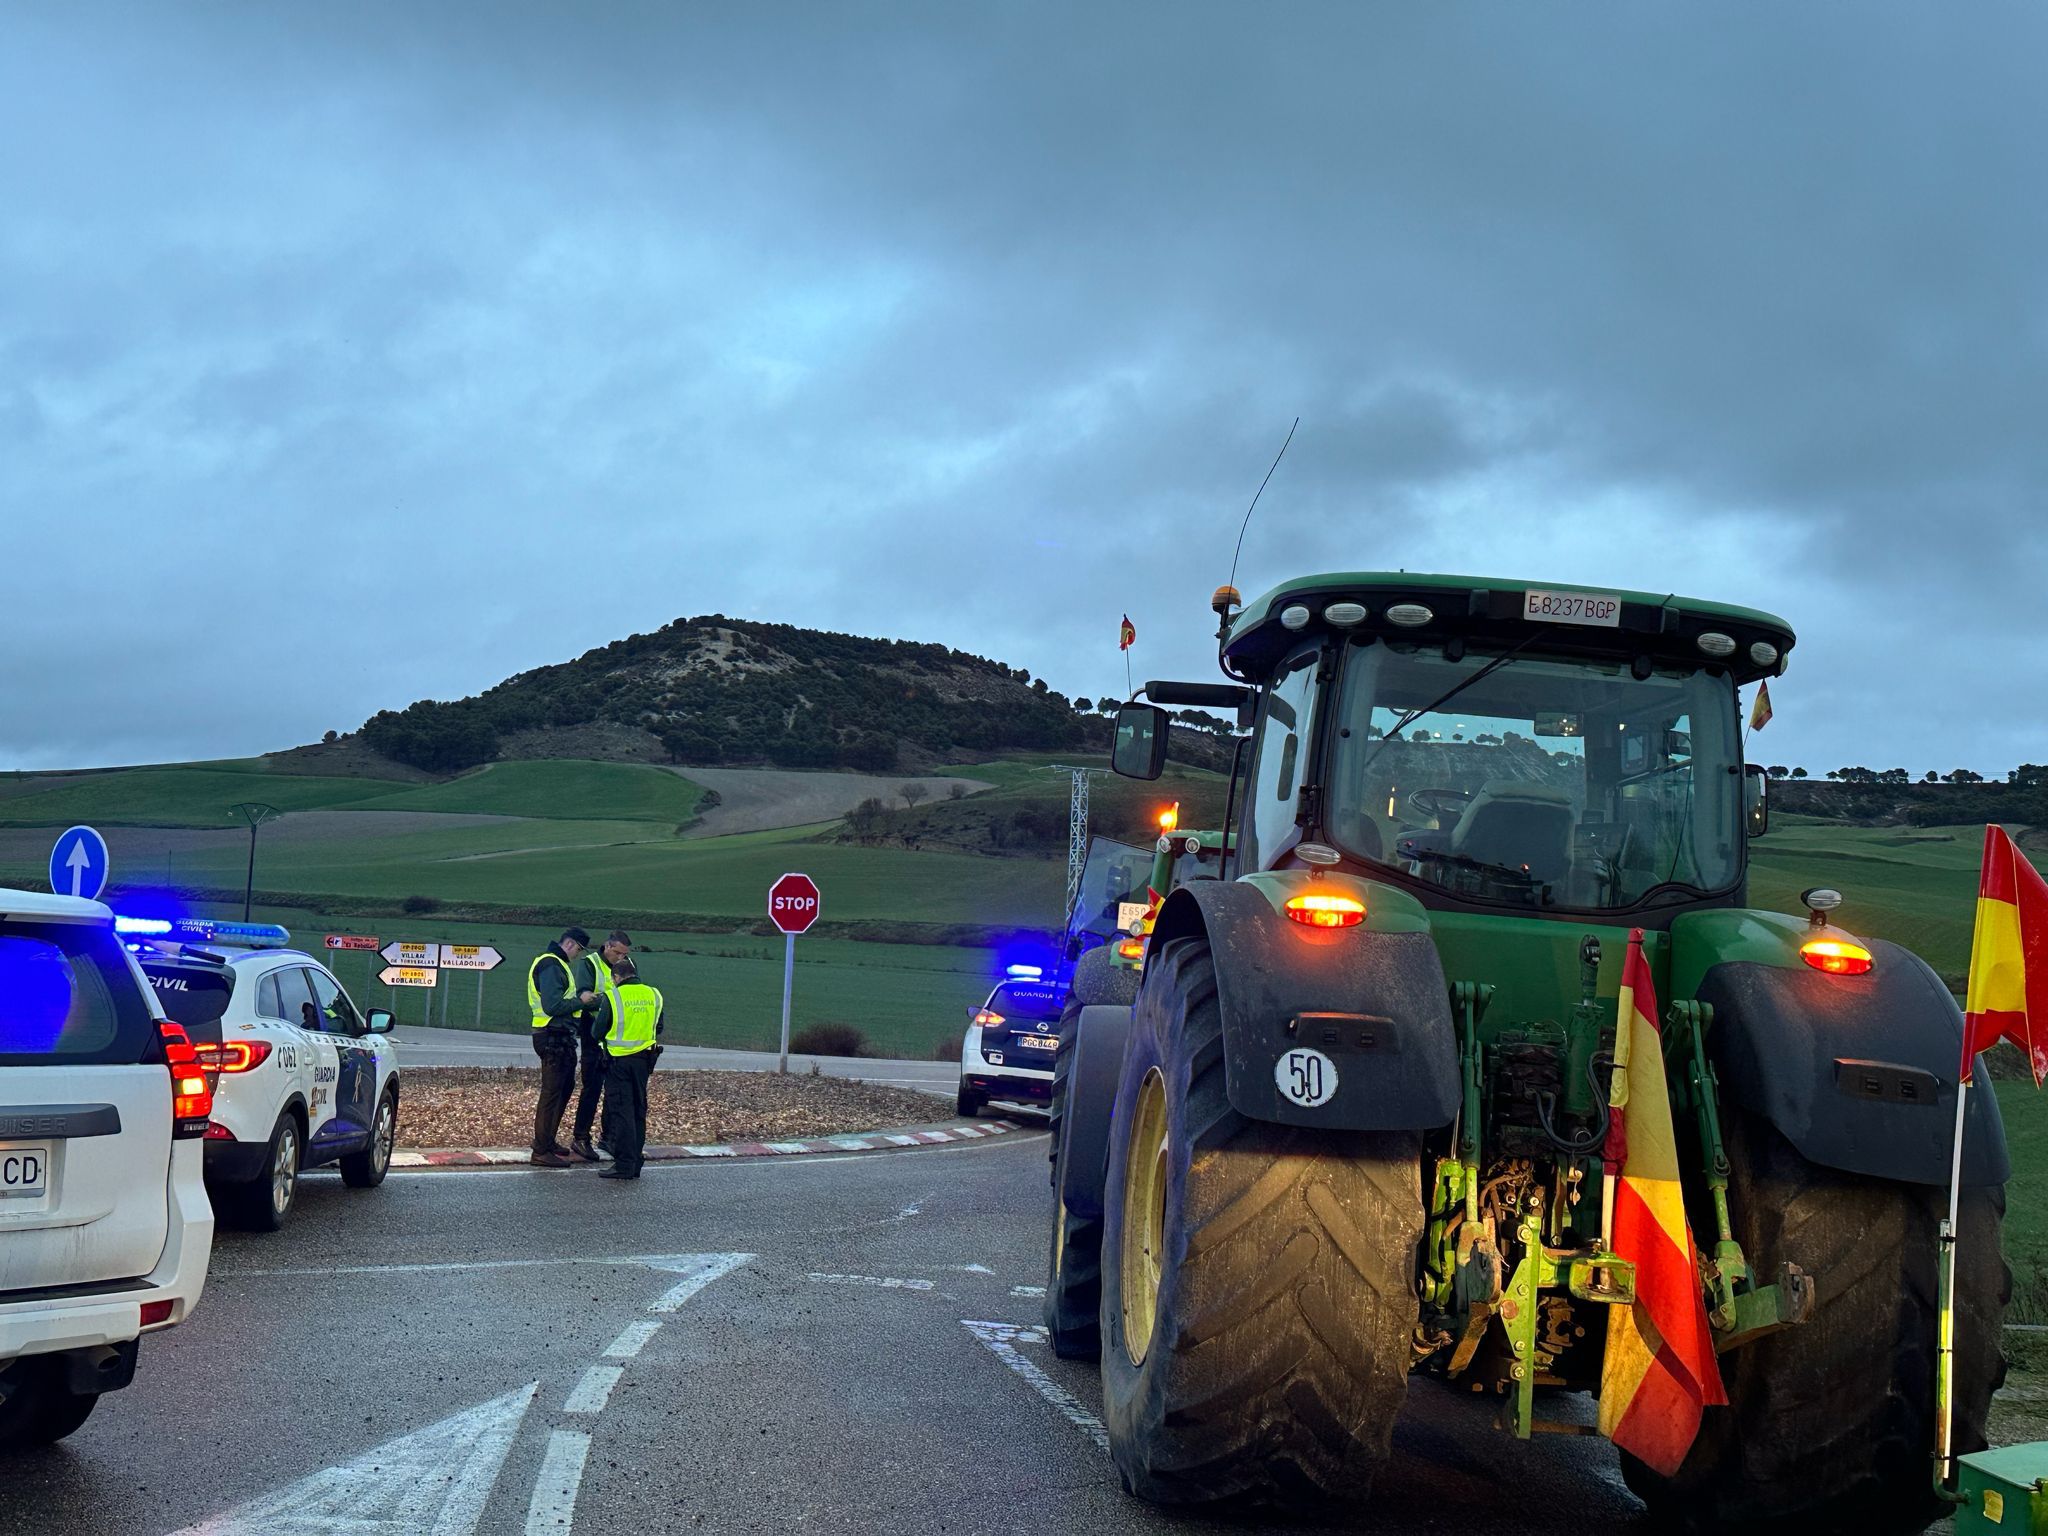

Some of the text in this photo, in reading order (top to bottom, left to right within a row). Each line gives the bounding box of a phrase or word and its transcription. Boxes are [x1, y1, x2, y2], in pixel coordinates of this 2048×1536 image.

[775, 897, 815, 911] STOP
[181, 925, 203, 933] CIVIL
[1013, 991, 1053, 999] GUARDIA
[283, 1046, 297, 1068] 062
[314, 1066, 336, 1083] GUARDIA
[1290, 1054, 1322, 1101] 50
